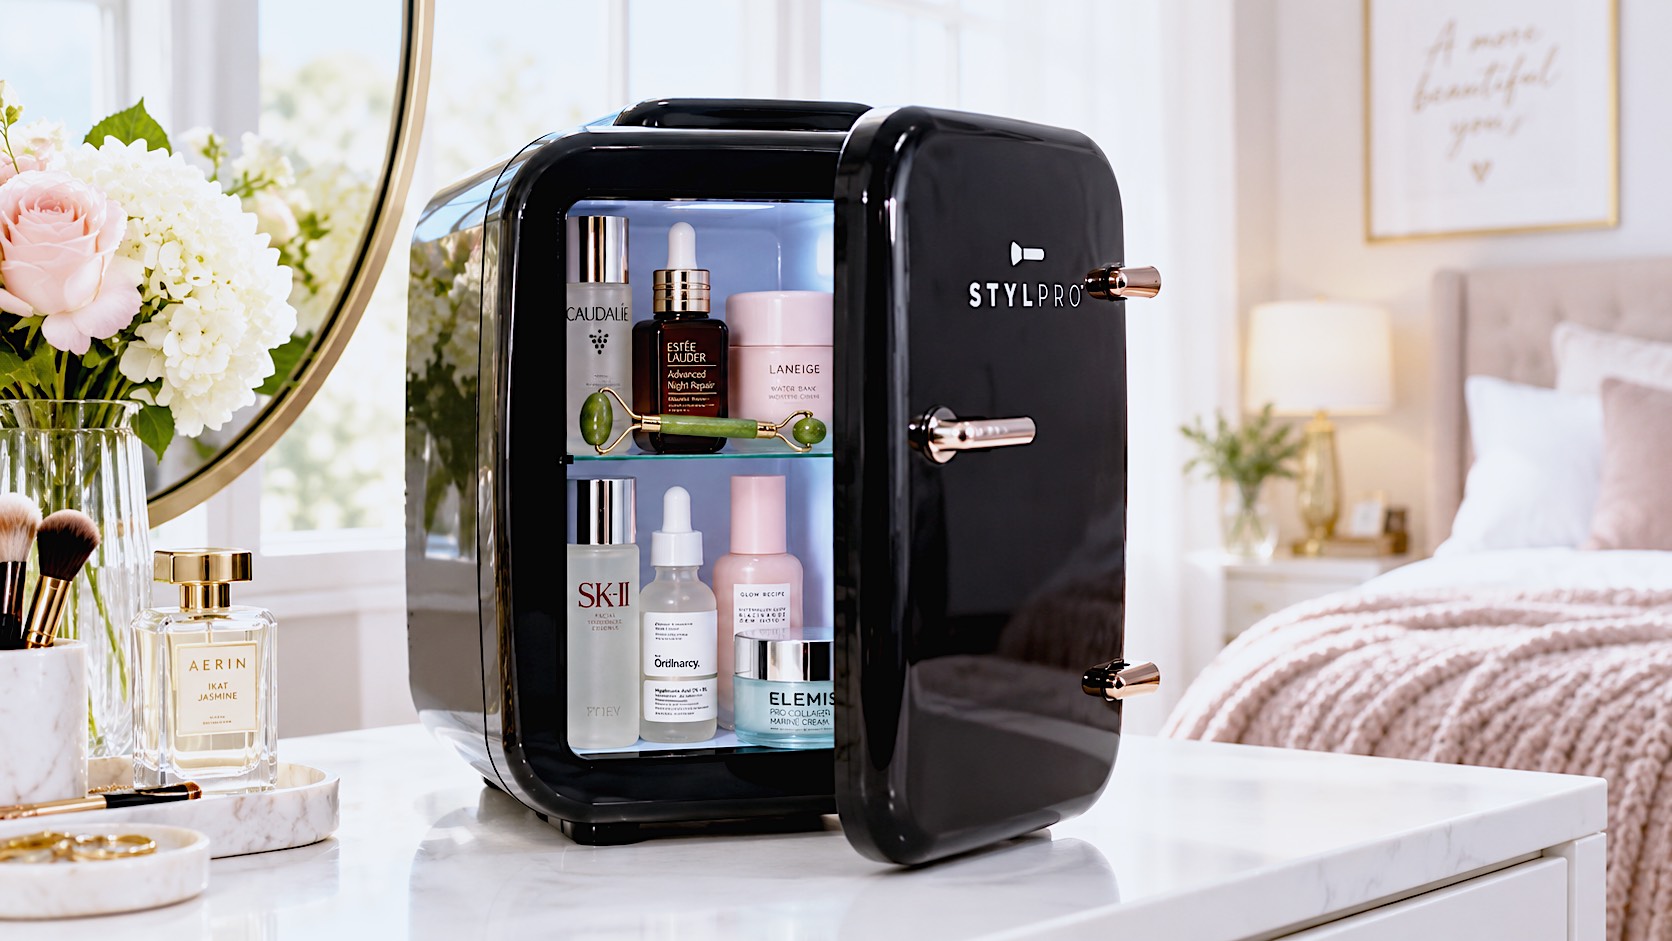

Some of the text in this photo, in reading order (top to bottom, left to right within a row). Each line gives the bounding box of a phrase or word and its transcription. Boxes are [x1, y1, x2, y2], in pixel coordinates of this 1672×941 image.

[1425, 18, 1544, 66] A more
[1412, 45, 1561, 112] beautiful
[968, 281, 1082, 308] STYLPRO
[667, 340, 697, 352] ESTÉE
[667, 352, 707, 363] LAUDER
[667, 370, 707, 379] Advanced
[769, 364, 820, 374] LANEIGE
[667, 381, 689, 391] Night
[578, 581, 630, 608] SK-II
[188, 658, 246, 672] AERIN
[208, 682, 229, 690] IKAT
[198, 691, 238, 702] JASMINE
[769, 691, 835, 706] ELEMIS
